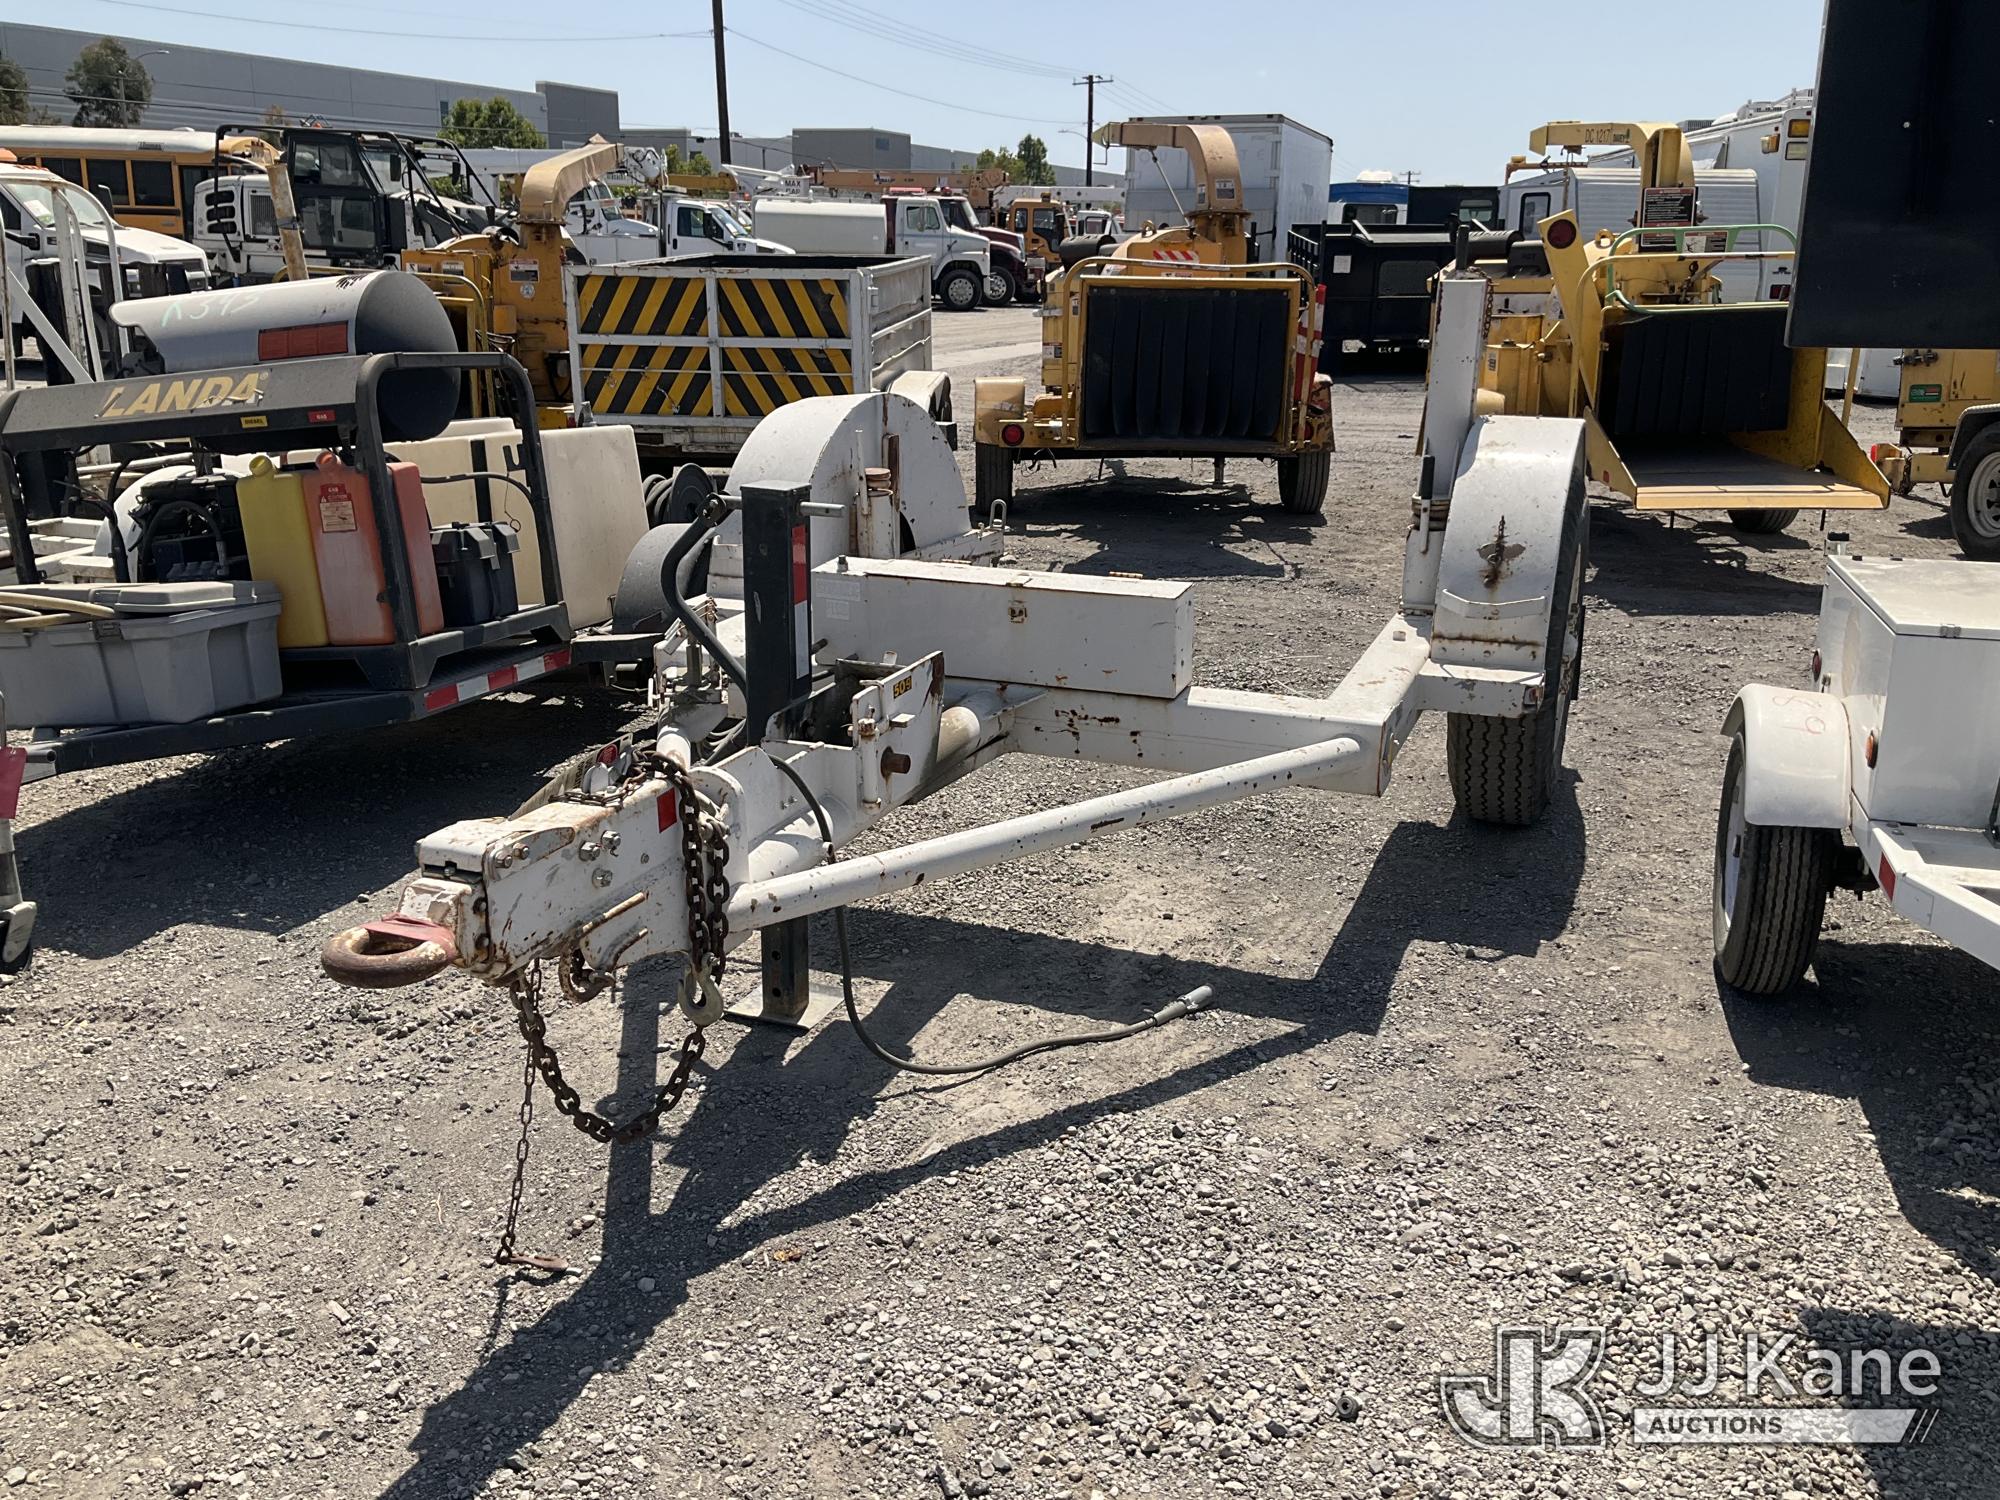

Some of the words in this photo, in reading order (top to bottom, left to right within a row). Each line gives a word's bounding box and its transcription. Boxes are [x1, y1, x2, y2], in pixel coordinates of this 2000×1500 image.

[1585, 128, 1594, 143] DC
[1596, 128, 1611, 143] 1217
[101, 371, 261, 418] LANDA
